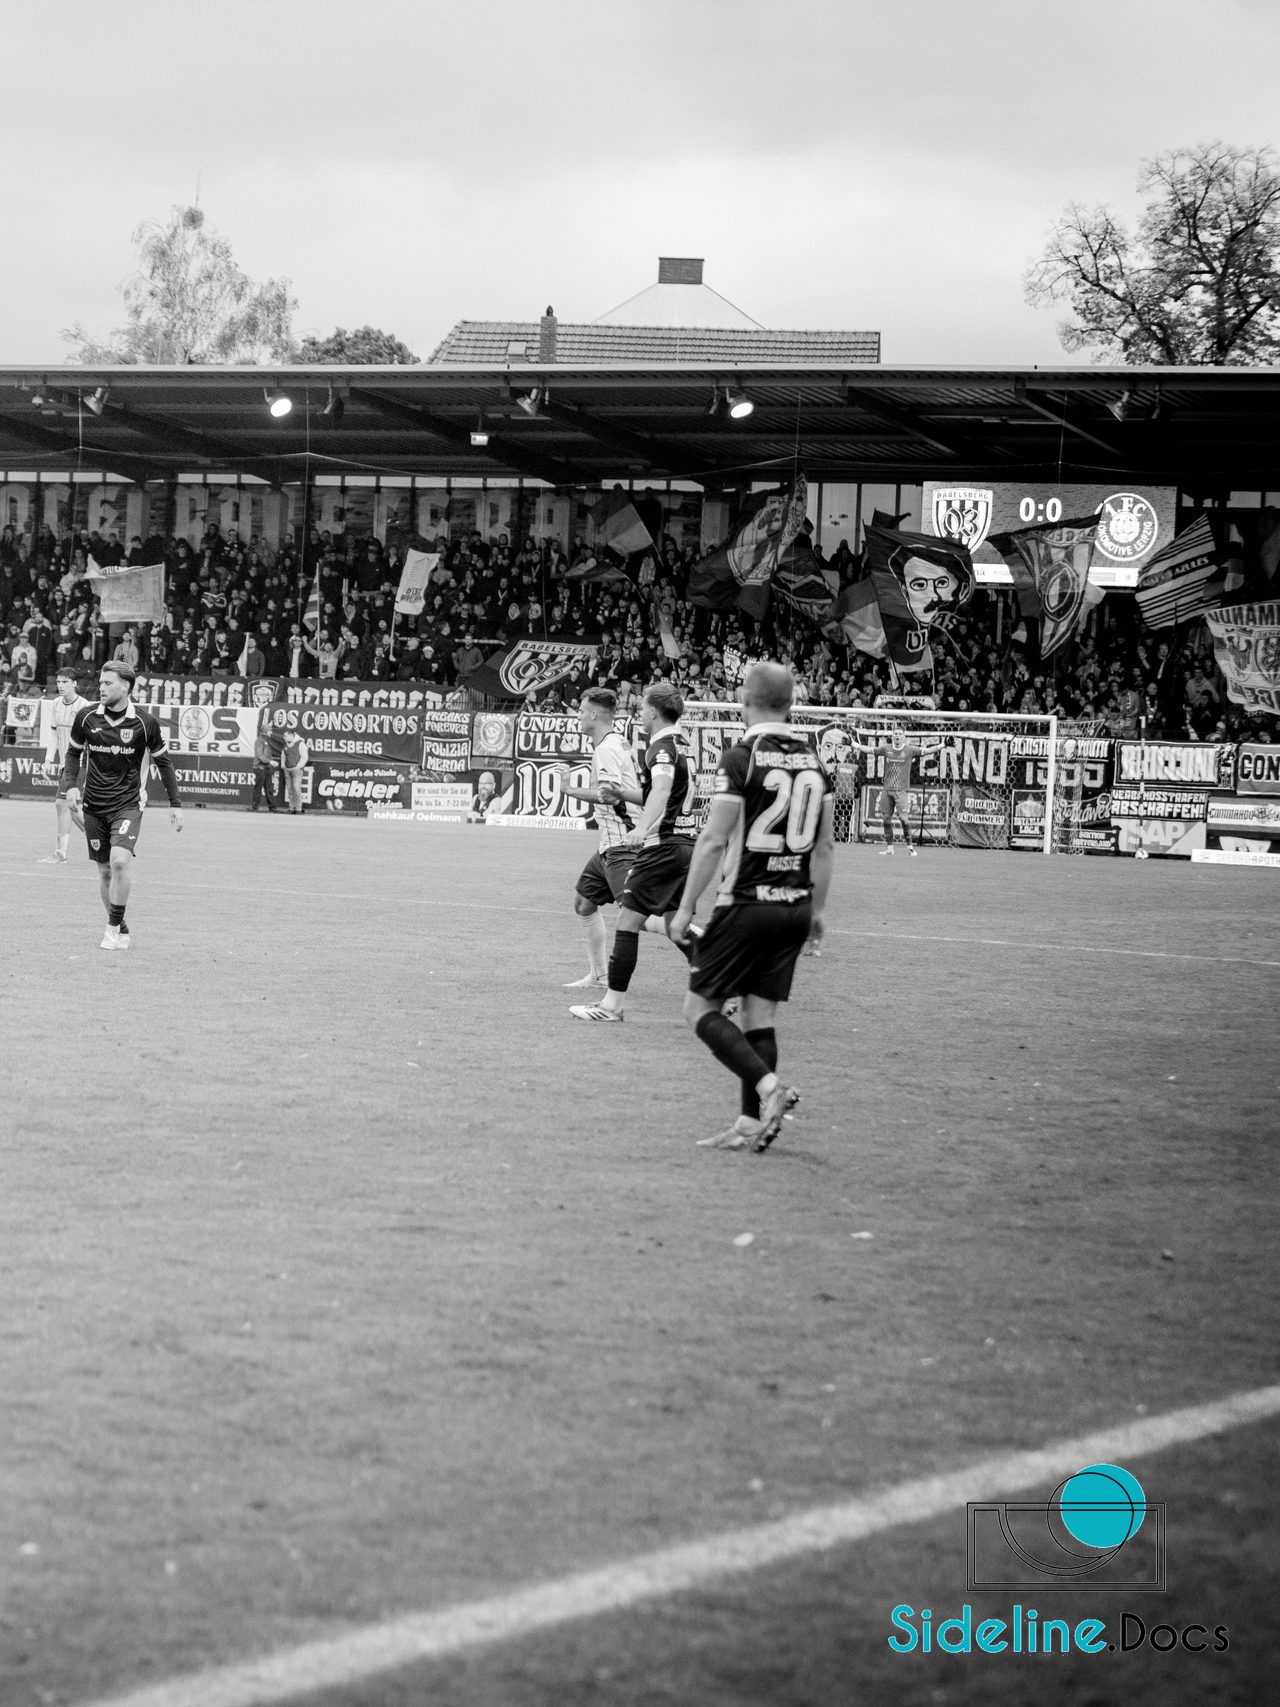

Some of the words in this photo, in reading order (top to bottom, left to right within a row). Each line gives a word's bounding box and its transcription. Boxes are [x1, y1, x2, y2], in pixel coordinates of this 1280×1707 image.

[1019, 496, 1062, 522] 0:0
[263, 708, 299, 729] LOS
[302, 711, 418, 735] CONSORTOS
[170, 741, 240, 753] BERG
[307, 738, 383, 755] ABELSBERG
[425, 741, 468, 757] POLIZIA
[426, 755, 466, 772] MERDA
[177, 785, 240, 796] ERNEHMENSGRUPPE
[318, 779, 400, 799] Gabler
[373, 811, 415, 821] nahkauf
[745, 769, 826, 853] 20
[117, 819, 131, 835] 8
[766, 855, 802, 871] HASSE
